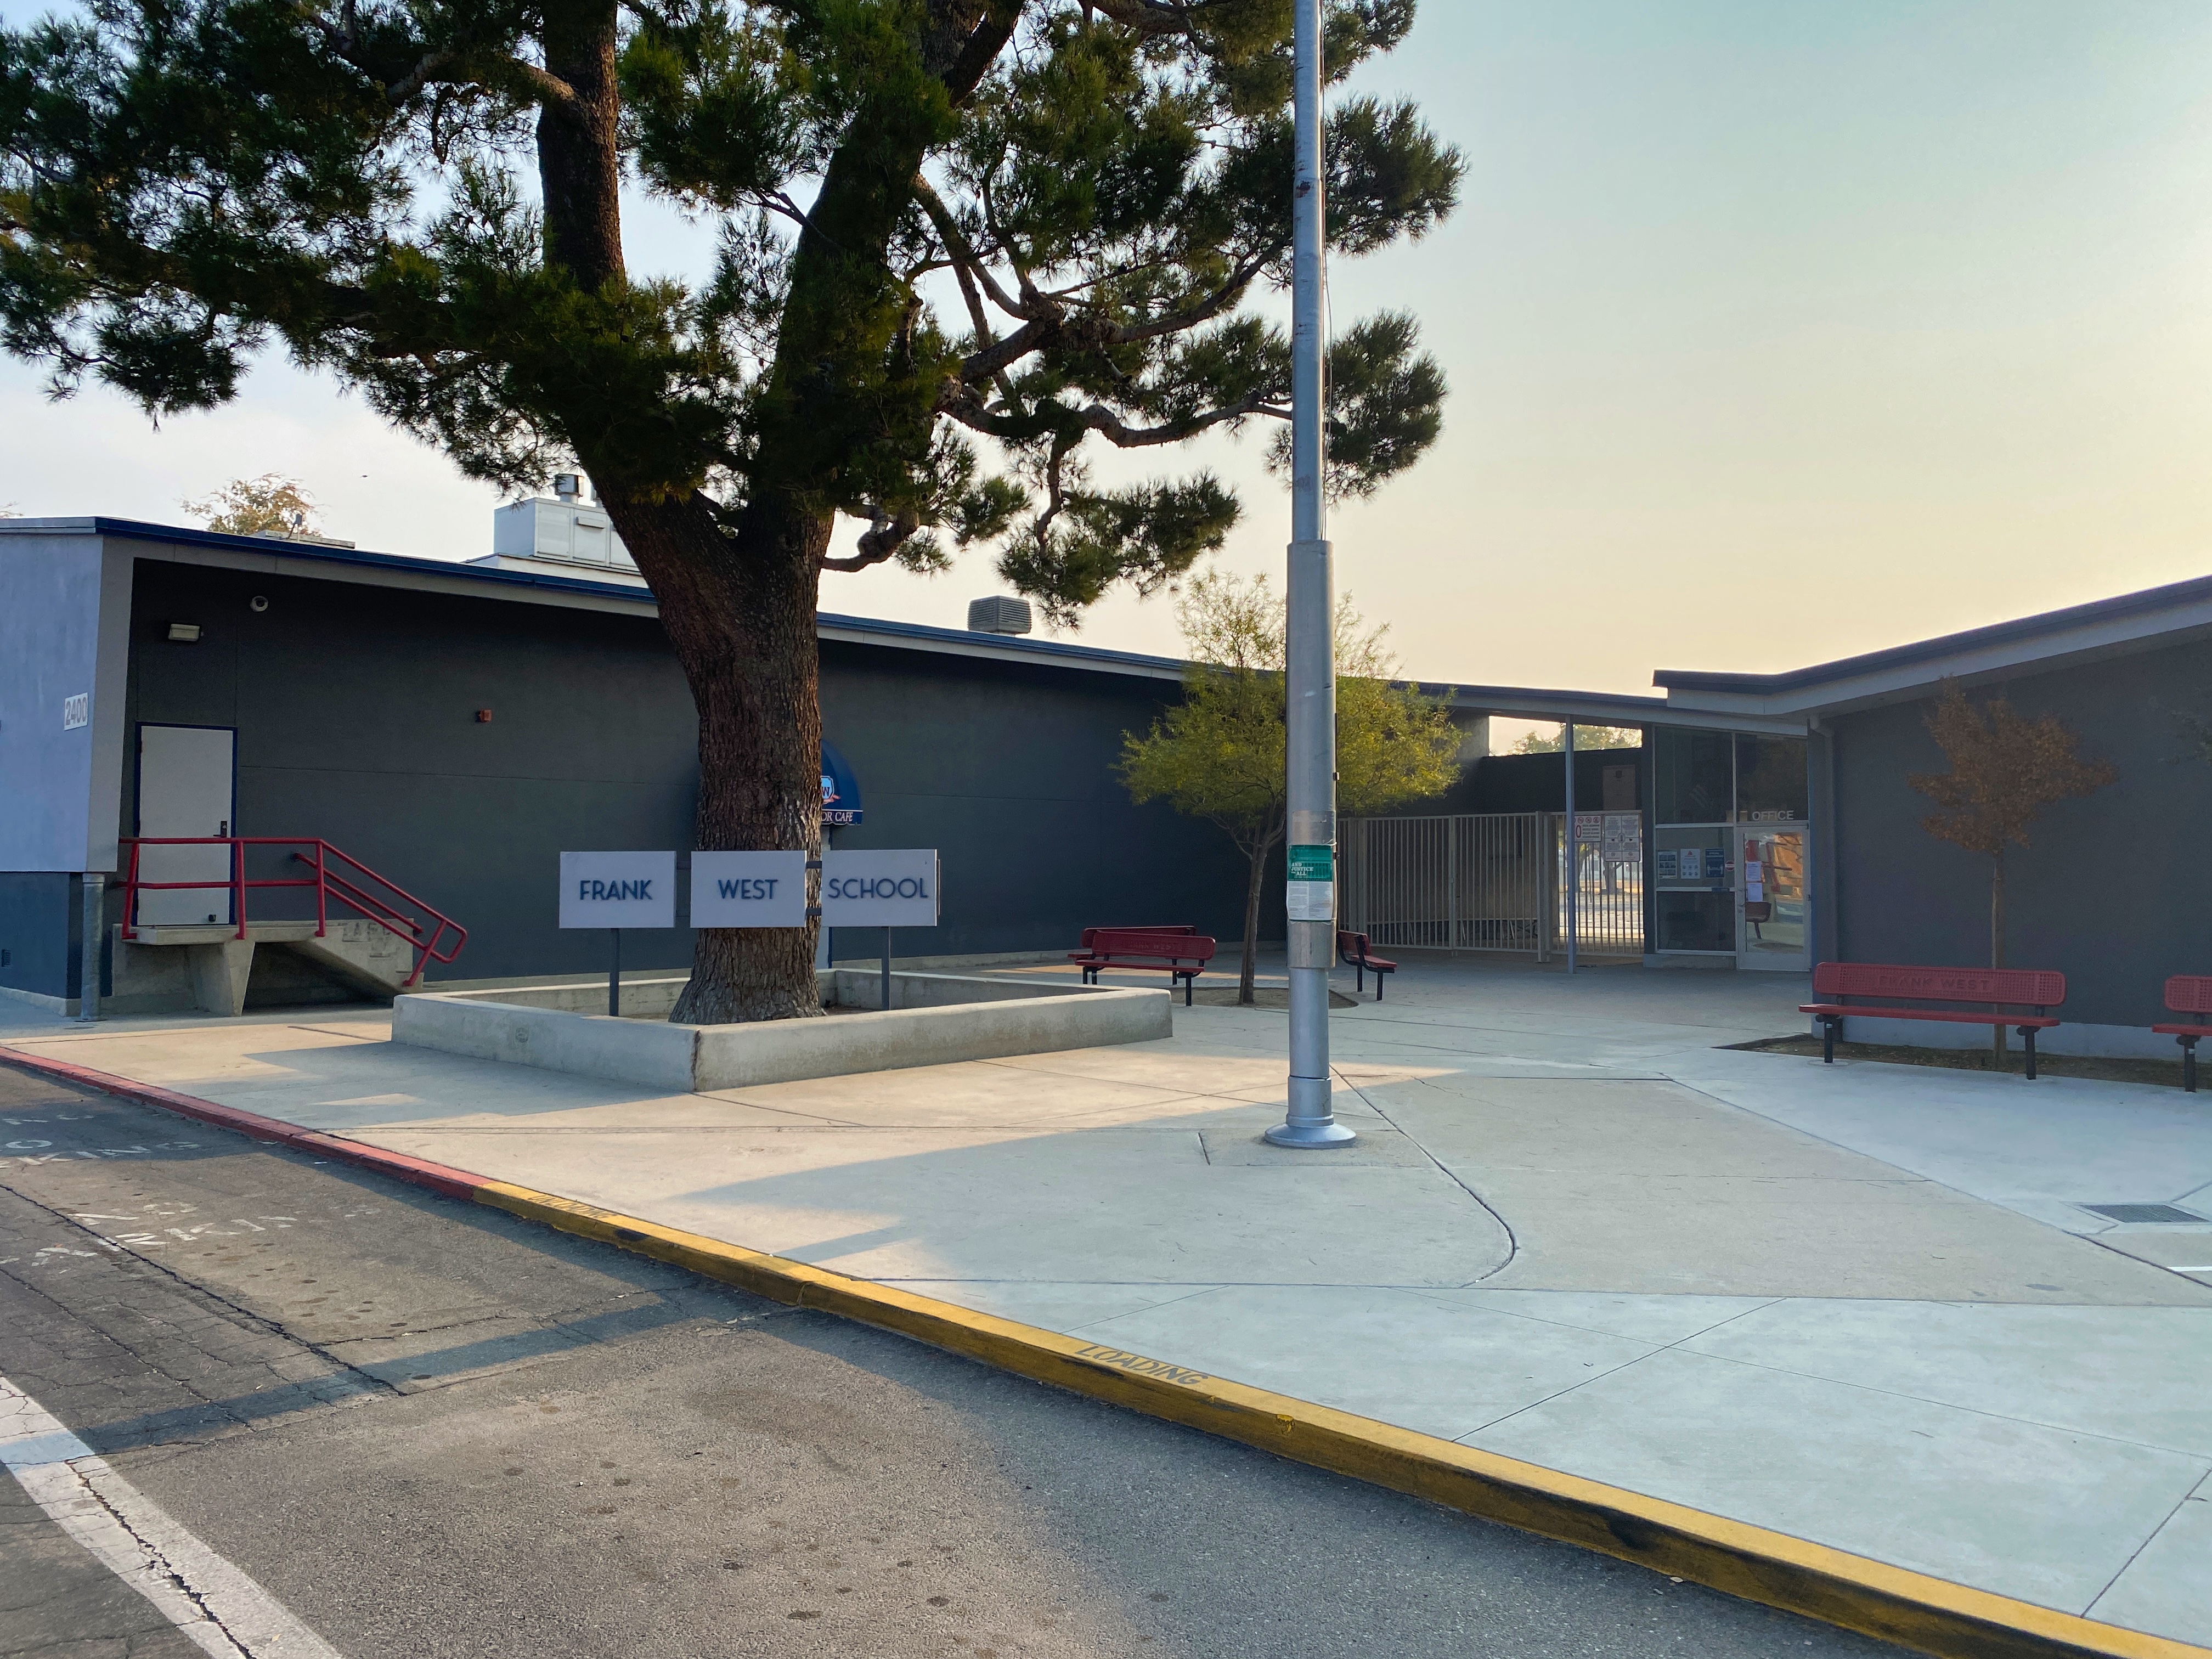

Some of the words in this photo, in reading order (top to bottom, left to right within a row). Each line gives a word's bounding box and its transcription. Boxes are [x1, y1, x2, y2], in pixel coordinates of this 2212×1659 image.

[65, 696, 88, 725] 2400
[834, 812, 854, 822] CAFE
[1752, 810, 1794, 821] OFFICE
[579, 879, 653, 900] FRANK
[718, 879, 778, 900] WEST
[827, 878, 929, 899] SCHOOL
[1940, 979, 1988, 991] WEST
[1074, 1345, 1209, 1385] LOADING
